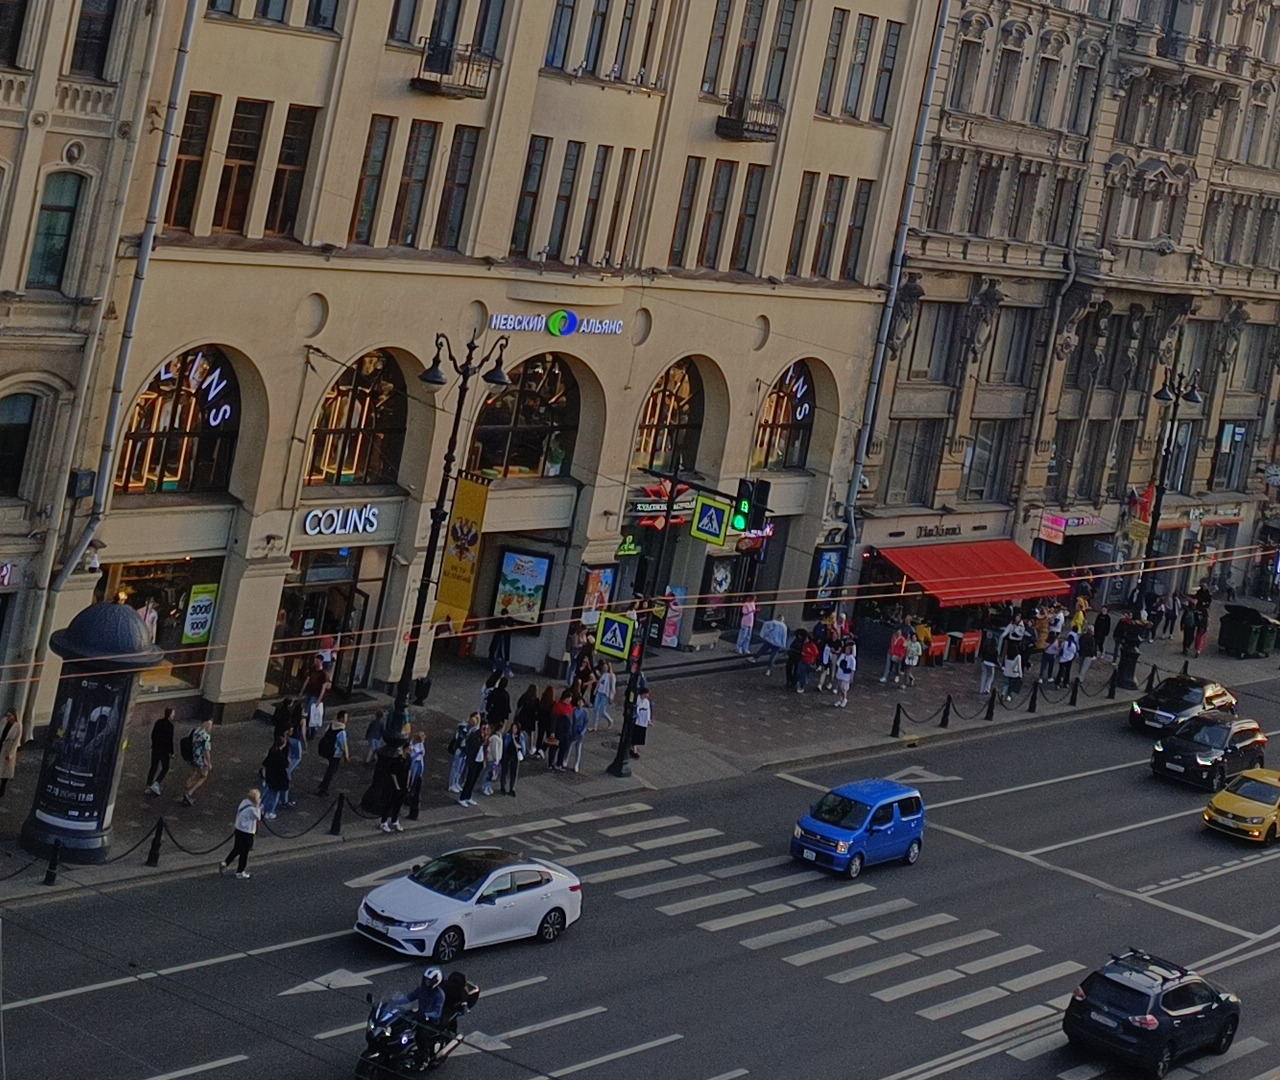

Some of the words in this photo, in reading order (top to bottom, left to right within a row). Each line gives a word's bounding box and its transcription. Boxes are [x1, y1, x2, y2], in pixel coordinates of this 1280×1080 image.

[490, 313, 547, 333] НЕВСКИЙ
[579, 319, 624, 335] АЛЬЯНС
[304, 503, 379, 536] COLIN'S
